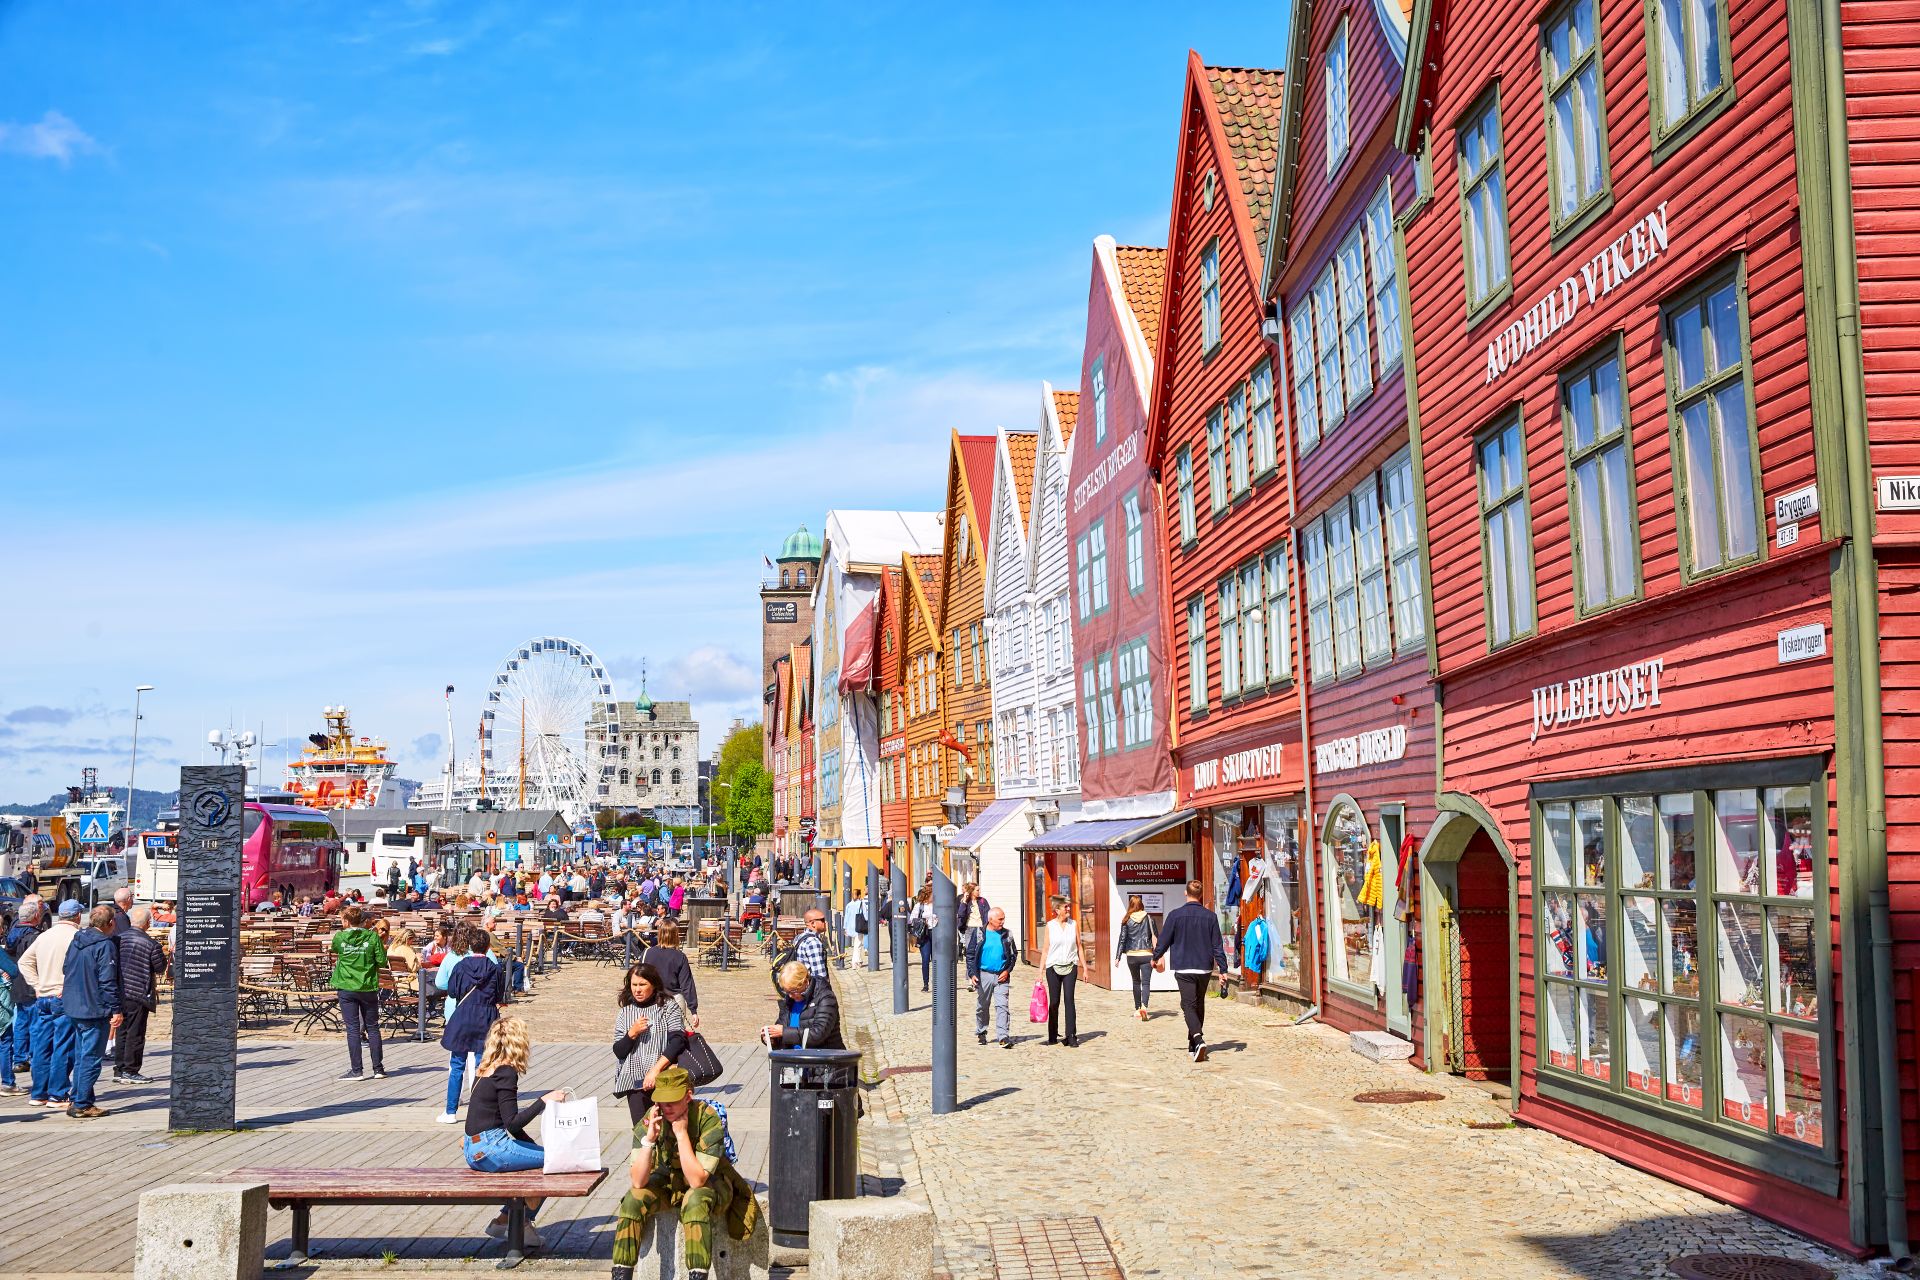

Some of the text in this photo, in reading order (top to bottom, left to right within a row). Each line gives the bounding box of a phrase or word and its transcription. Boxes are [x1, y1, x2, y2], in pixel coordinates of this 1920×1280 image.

[1486, 200, 1669, 384] AUDHILD VIKEN
[1778, 494, 1812, 519] Bryggen
[1781, 634, 1822, 658] Tyskebryggen
[1531, 657, 1664, 742] JULEHUSET
[1194, 742, 1283, 790] KNUT SKURTVEIT
[558, 1116, 587, 1126] HEIM
